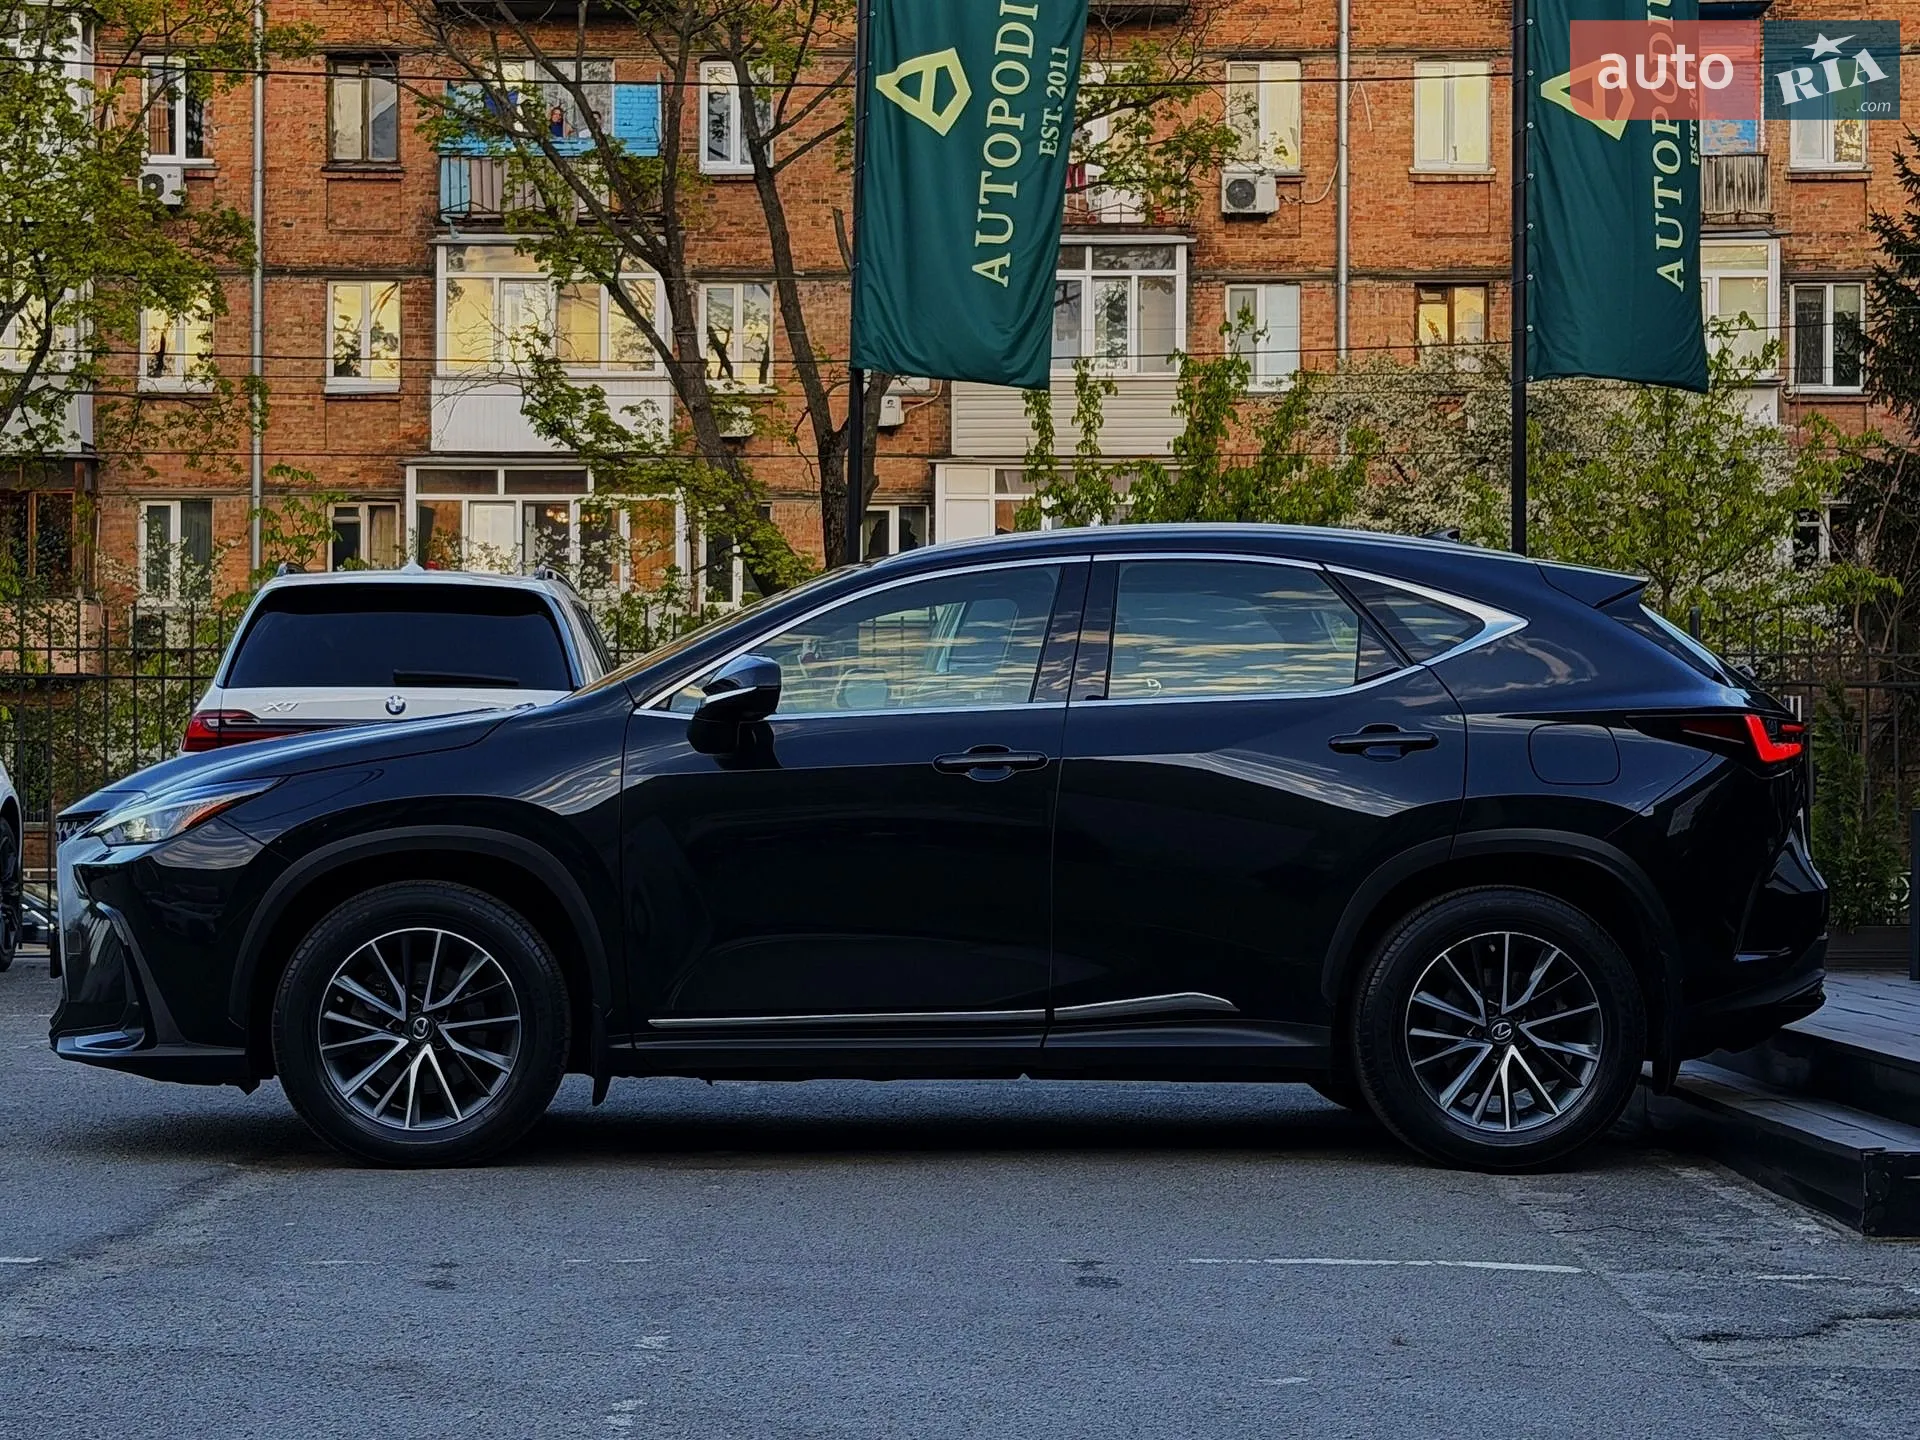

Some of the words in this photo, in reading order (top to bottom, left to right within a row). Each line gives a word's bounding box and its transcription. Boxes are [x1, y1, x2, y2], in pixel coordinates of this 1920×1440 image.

[1046, 47, 1070, 99] 2011
[1038, 105, 1063, 158] EST.
[263, 702, 299, 712] X7
